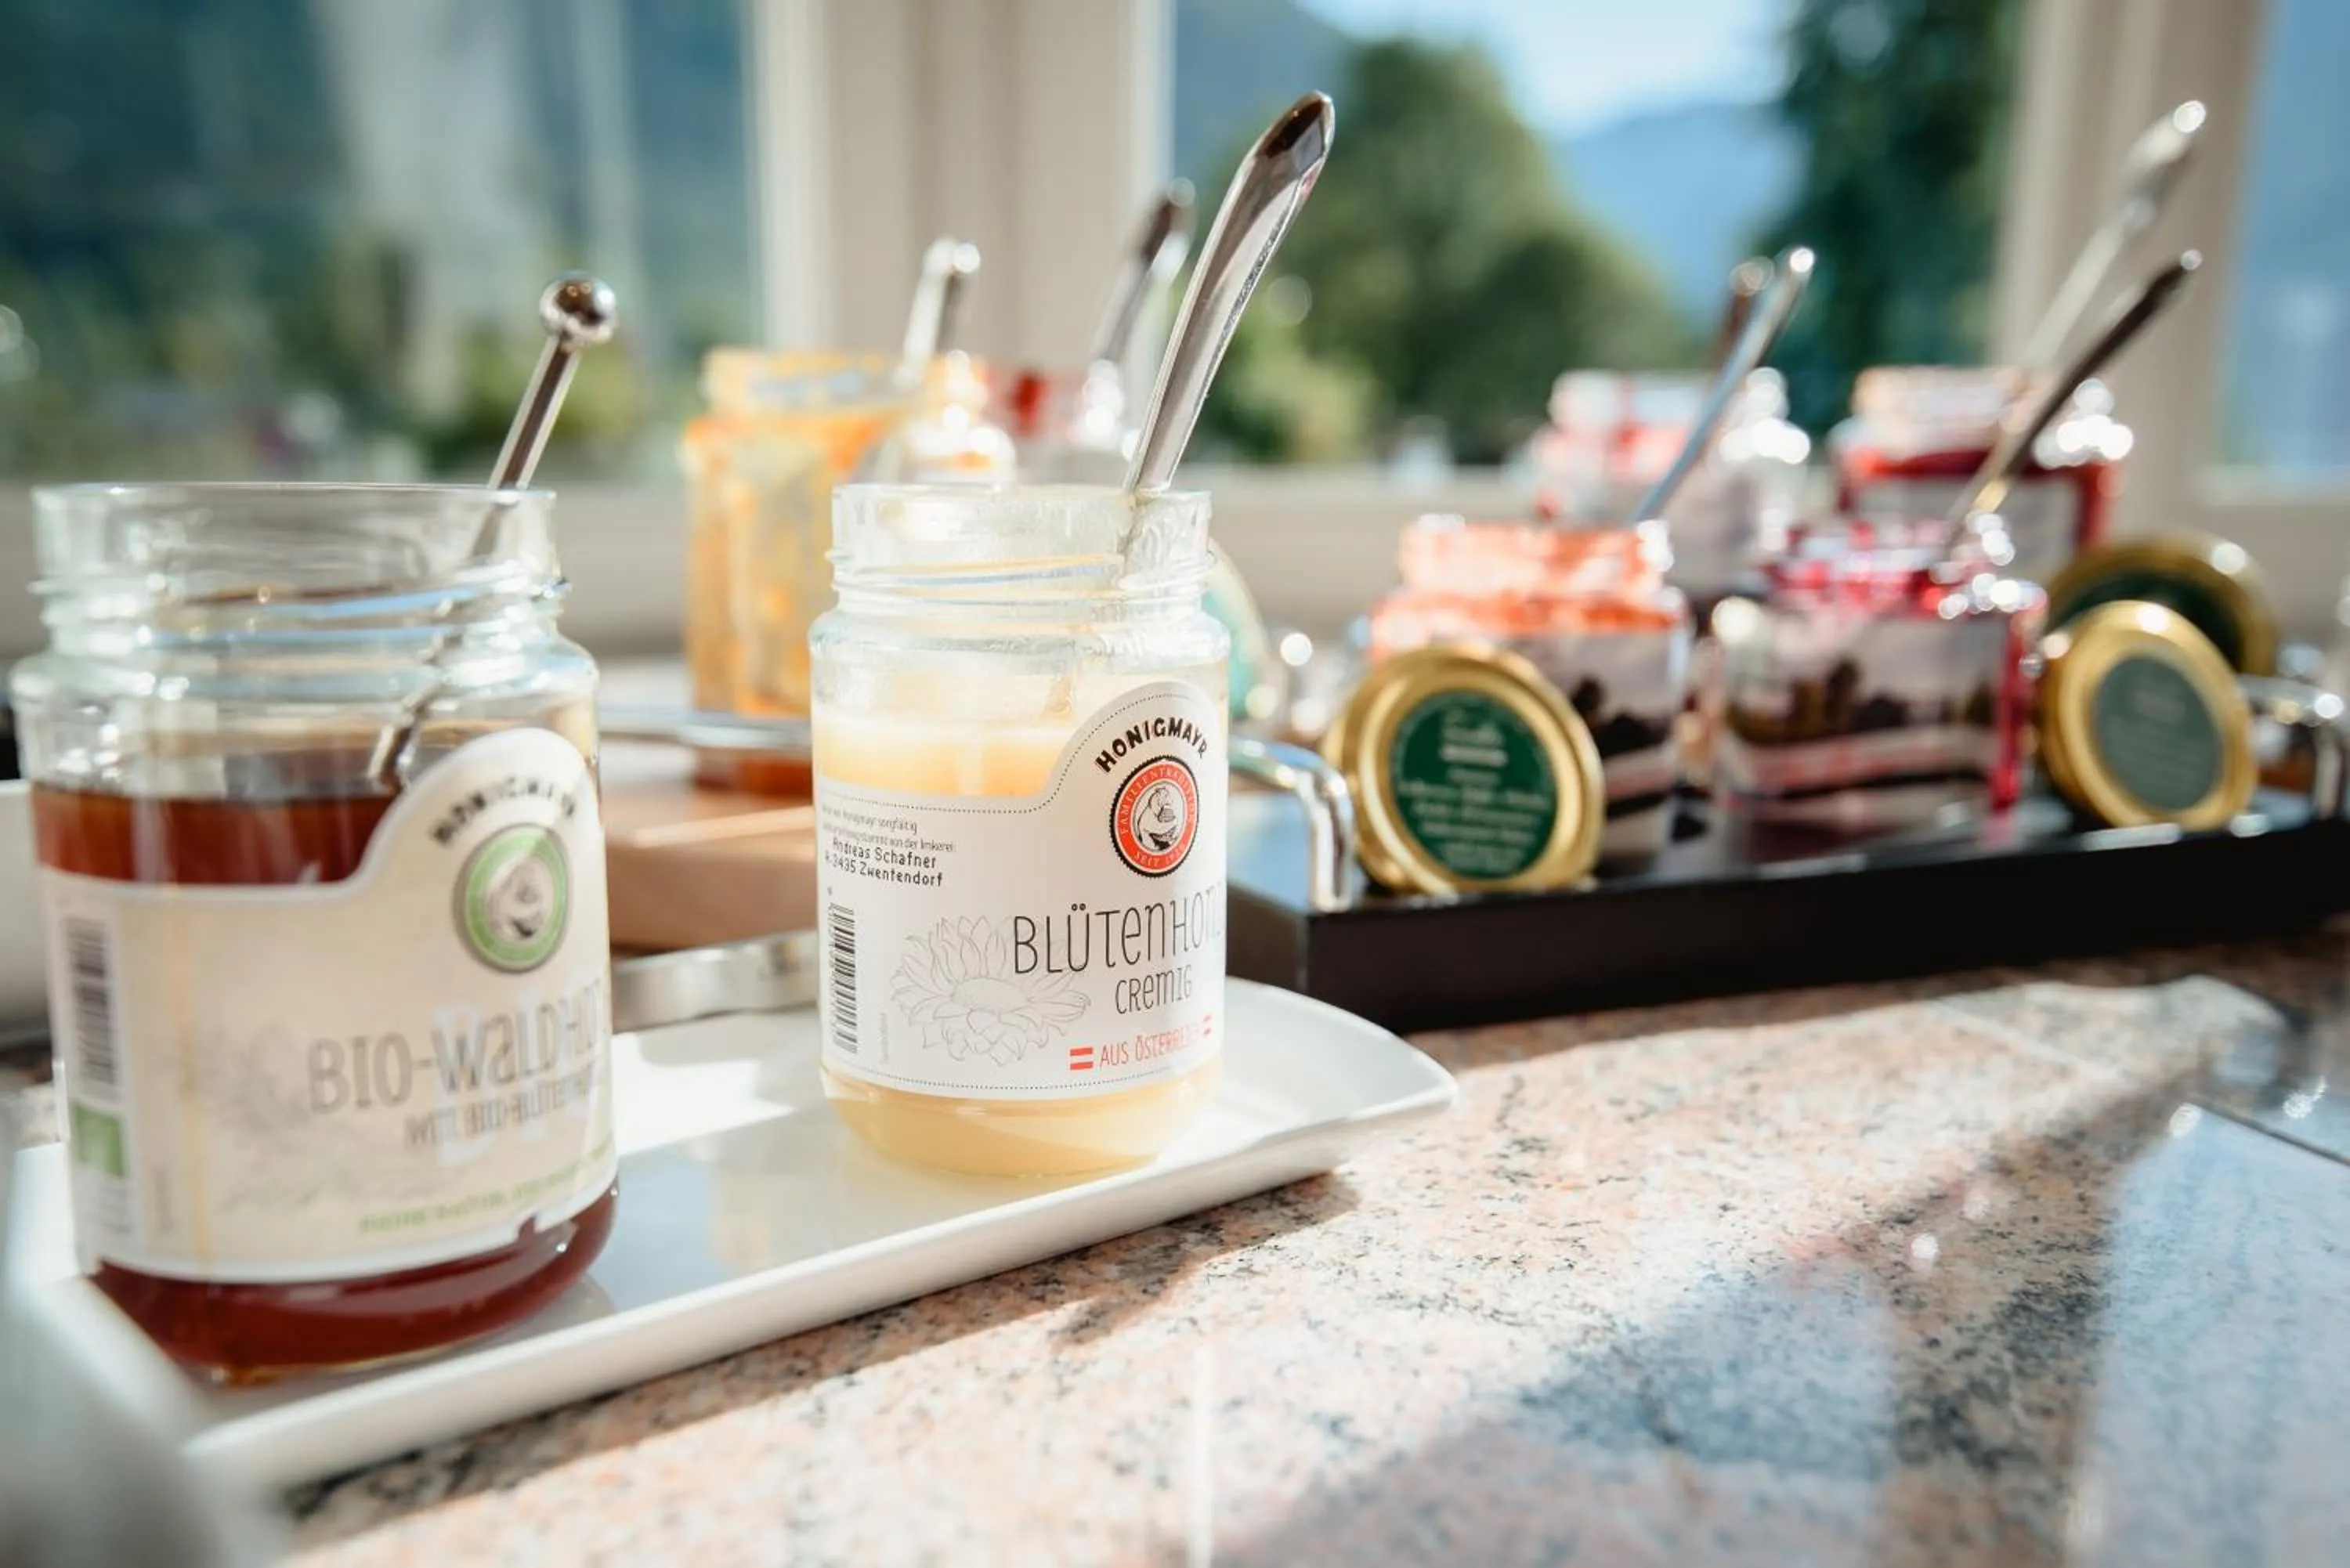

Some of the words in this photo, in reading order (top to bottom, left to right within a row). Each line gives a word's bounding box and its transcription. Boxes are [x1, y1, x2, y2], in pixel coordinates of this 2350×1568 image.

[1095, 717, 1207, 773] HONIGMAYR
[833, 836, 870, 859] Andreas
[874, 847, 936, 869] Schafner
[860, 861, 943, 887] Zwentendorf
[1099, 1041, 1130, 1068] AUS
